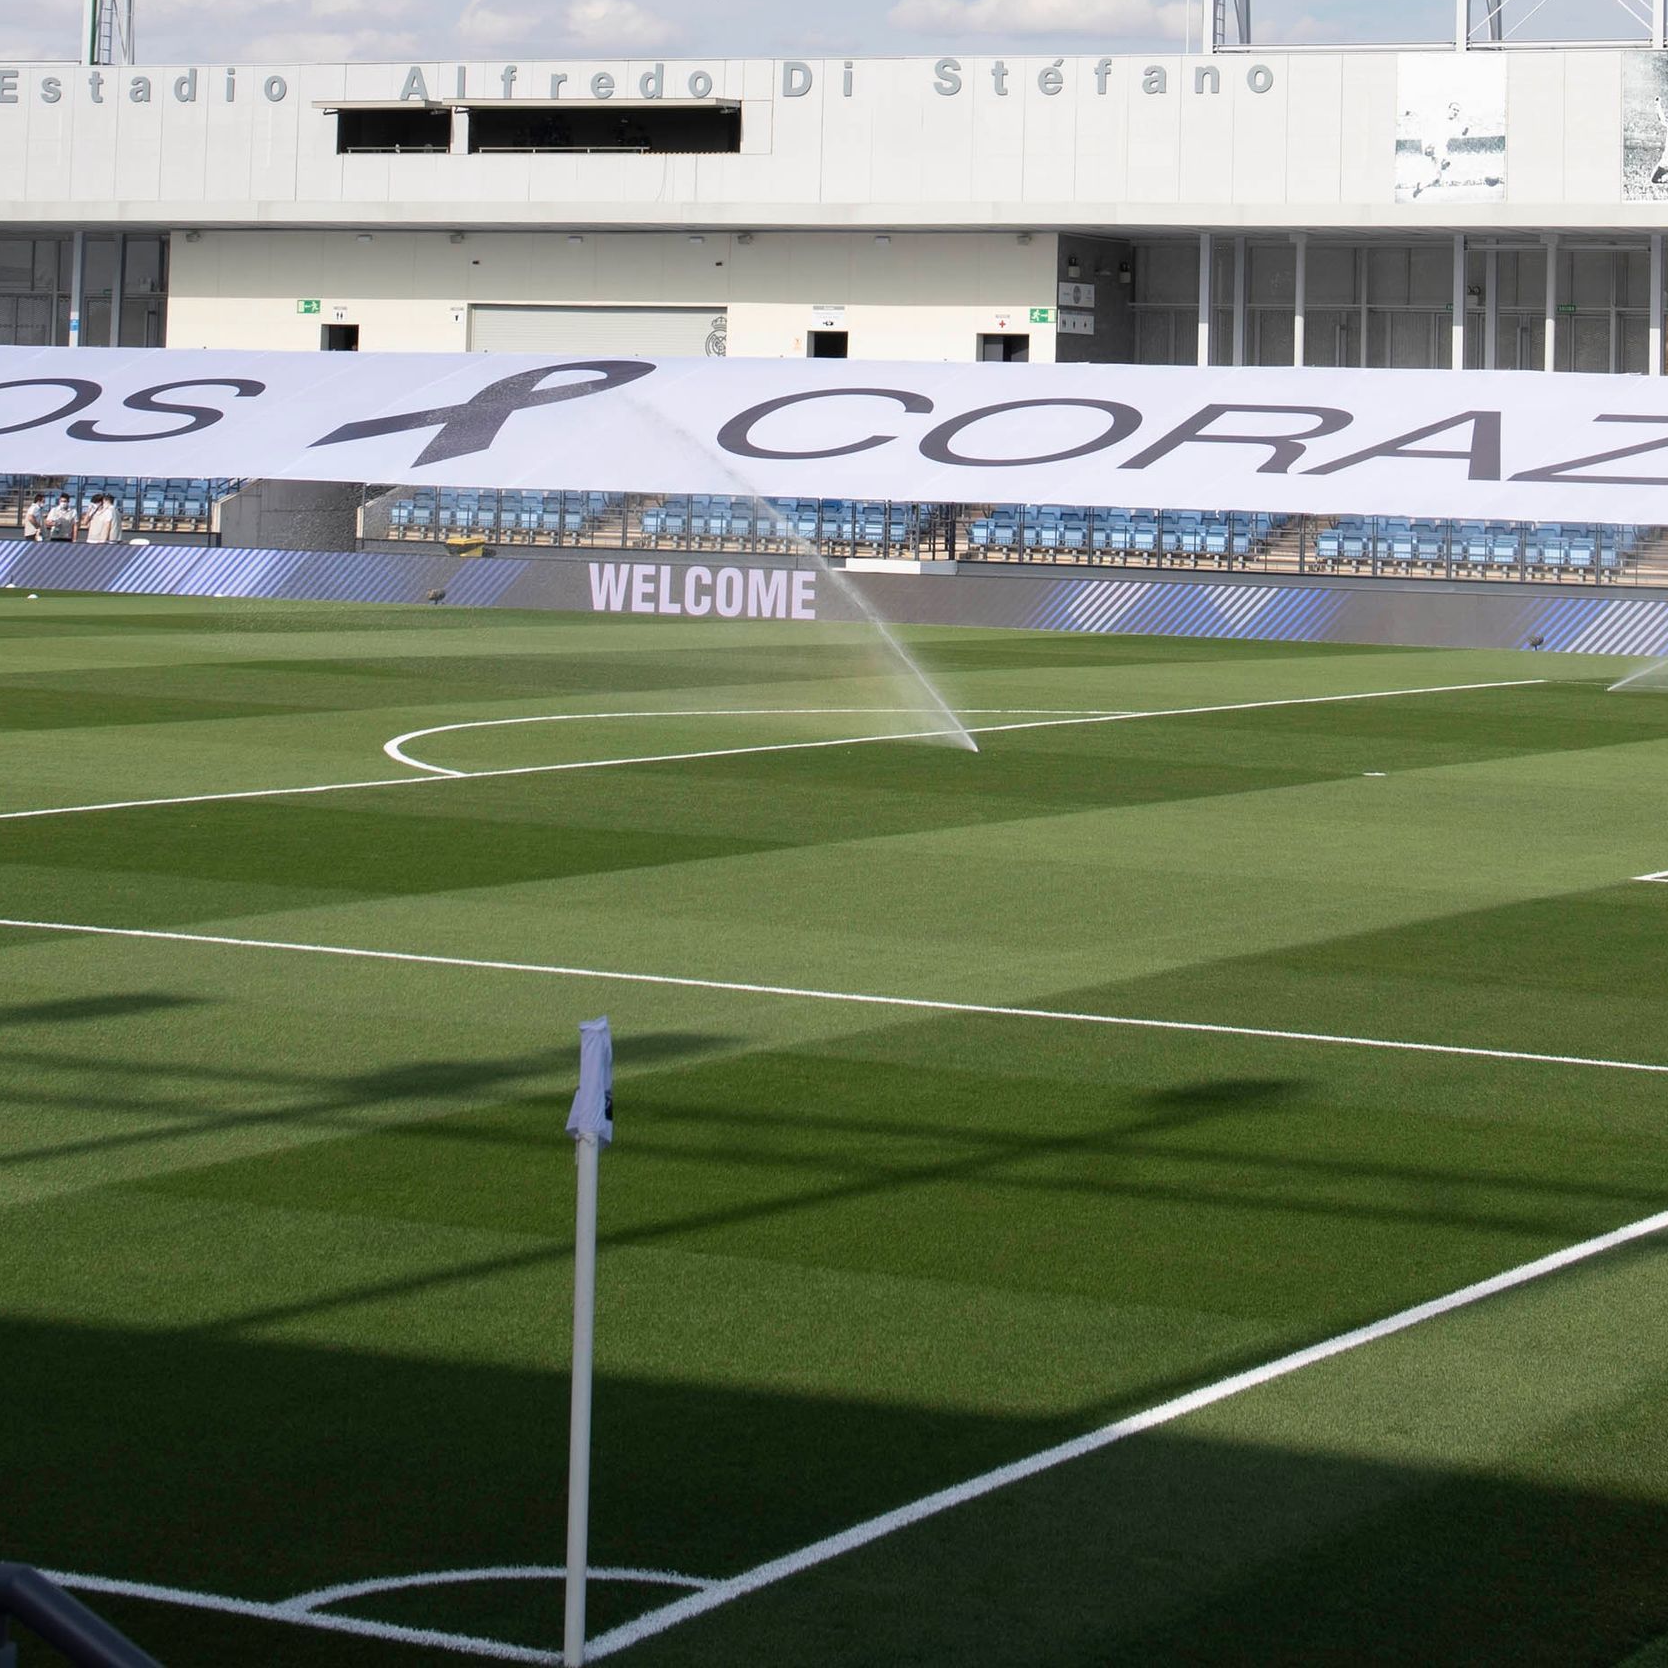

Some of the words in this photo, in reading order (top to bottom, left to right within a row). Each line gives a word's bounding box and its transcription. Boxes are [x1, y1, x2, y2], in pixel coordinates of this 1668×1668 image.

[399, 63, 713, 101] Alfredo
[782, 60, 855, 98] Di
[934, 57, 1274, 97] Stéfano
[588, 561, 816, 620] WELCOME
